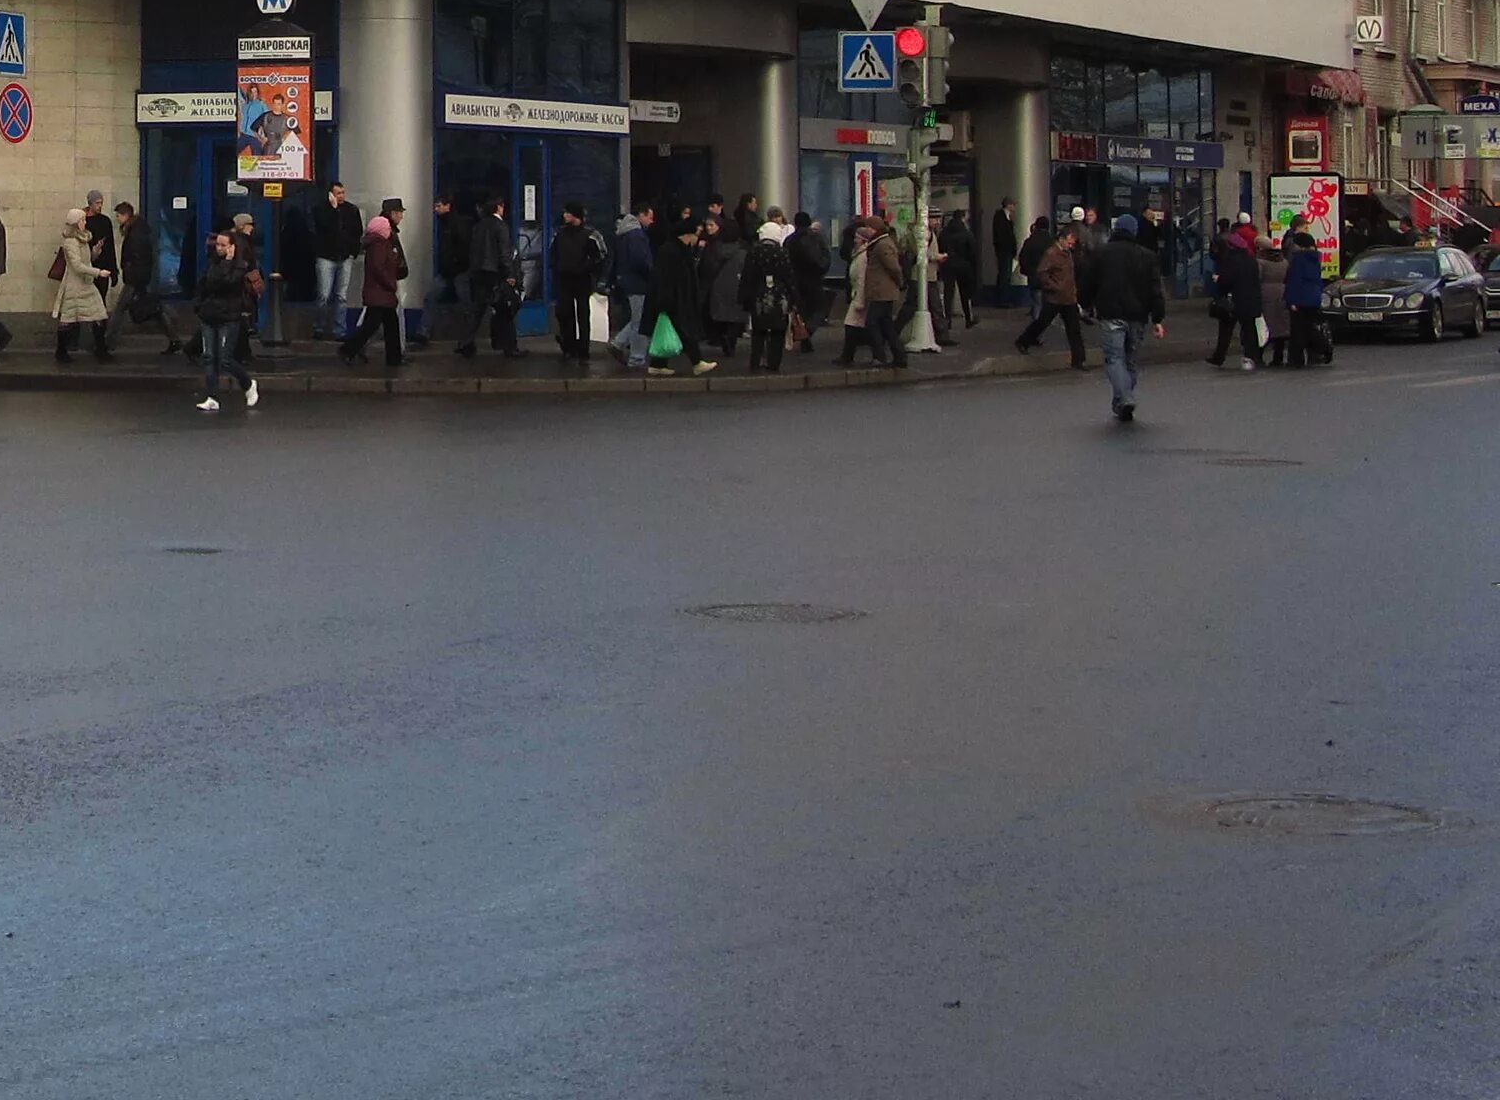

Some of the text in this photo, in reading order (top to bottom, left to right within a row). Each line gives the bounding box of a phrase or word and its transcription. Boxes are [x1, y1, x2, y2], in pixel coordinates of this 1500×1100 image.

[239, 40, 309, 52] ЕЛИЗАРОВСКАЯ
[1463, 102, 1497, 111] МЕХА
[451, 103, 626, 125] АВИАБИЛЕТЫ ЖЕЛЕЗНОДОРОЖНЫЕ КАССЫ
